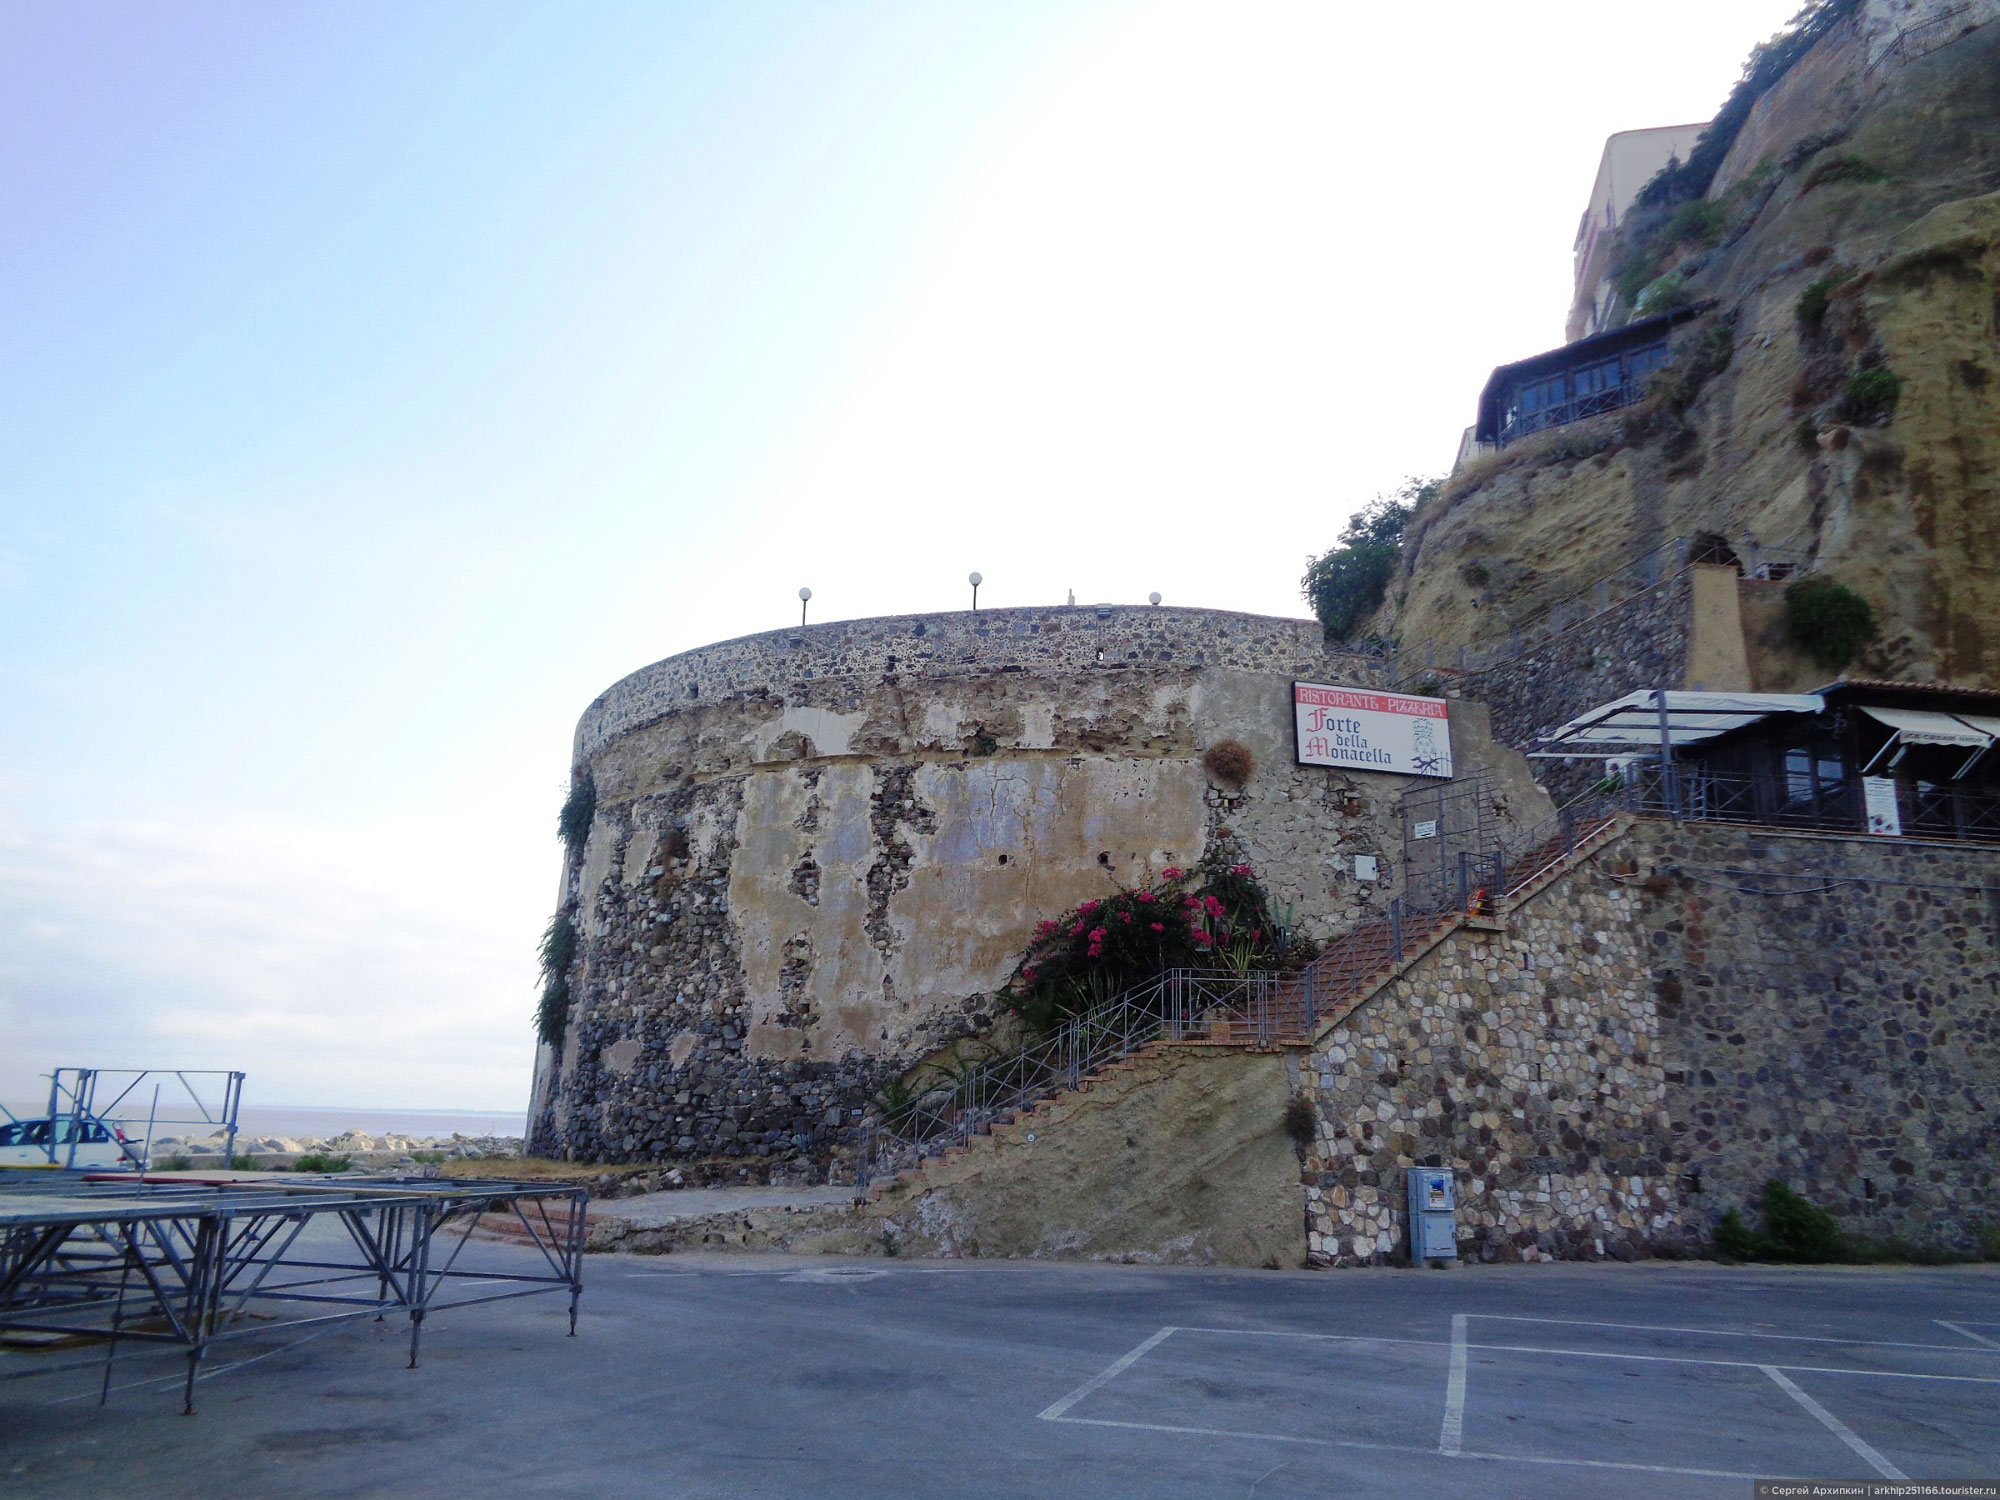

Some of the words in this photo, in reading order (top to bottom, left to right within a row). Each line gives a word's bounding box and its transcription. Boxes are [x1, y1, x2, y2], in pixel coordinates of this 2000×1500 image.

[1299, 688, 1379, 709] RISTORANTE
[1387, 698, 1443, 717] PIZZERIA
[1306, 707, 1361, 734] Forte
[1305, 736, 1392, 764] Monacella
[1336, 733, 1368, 748] della
